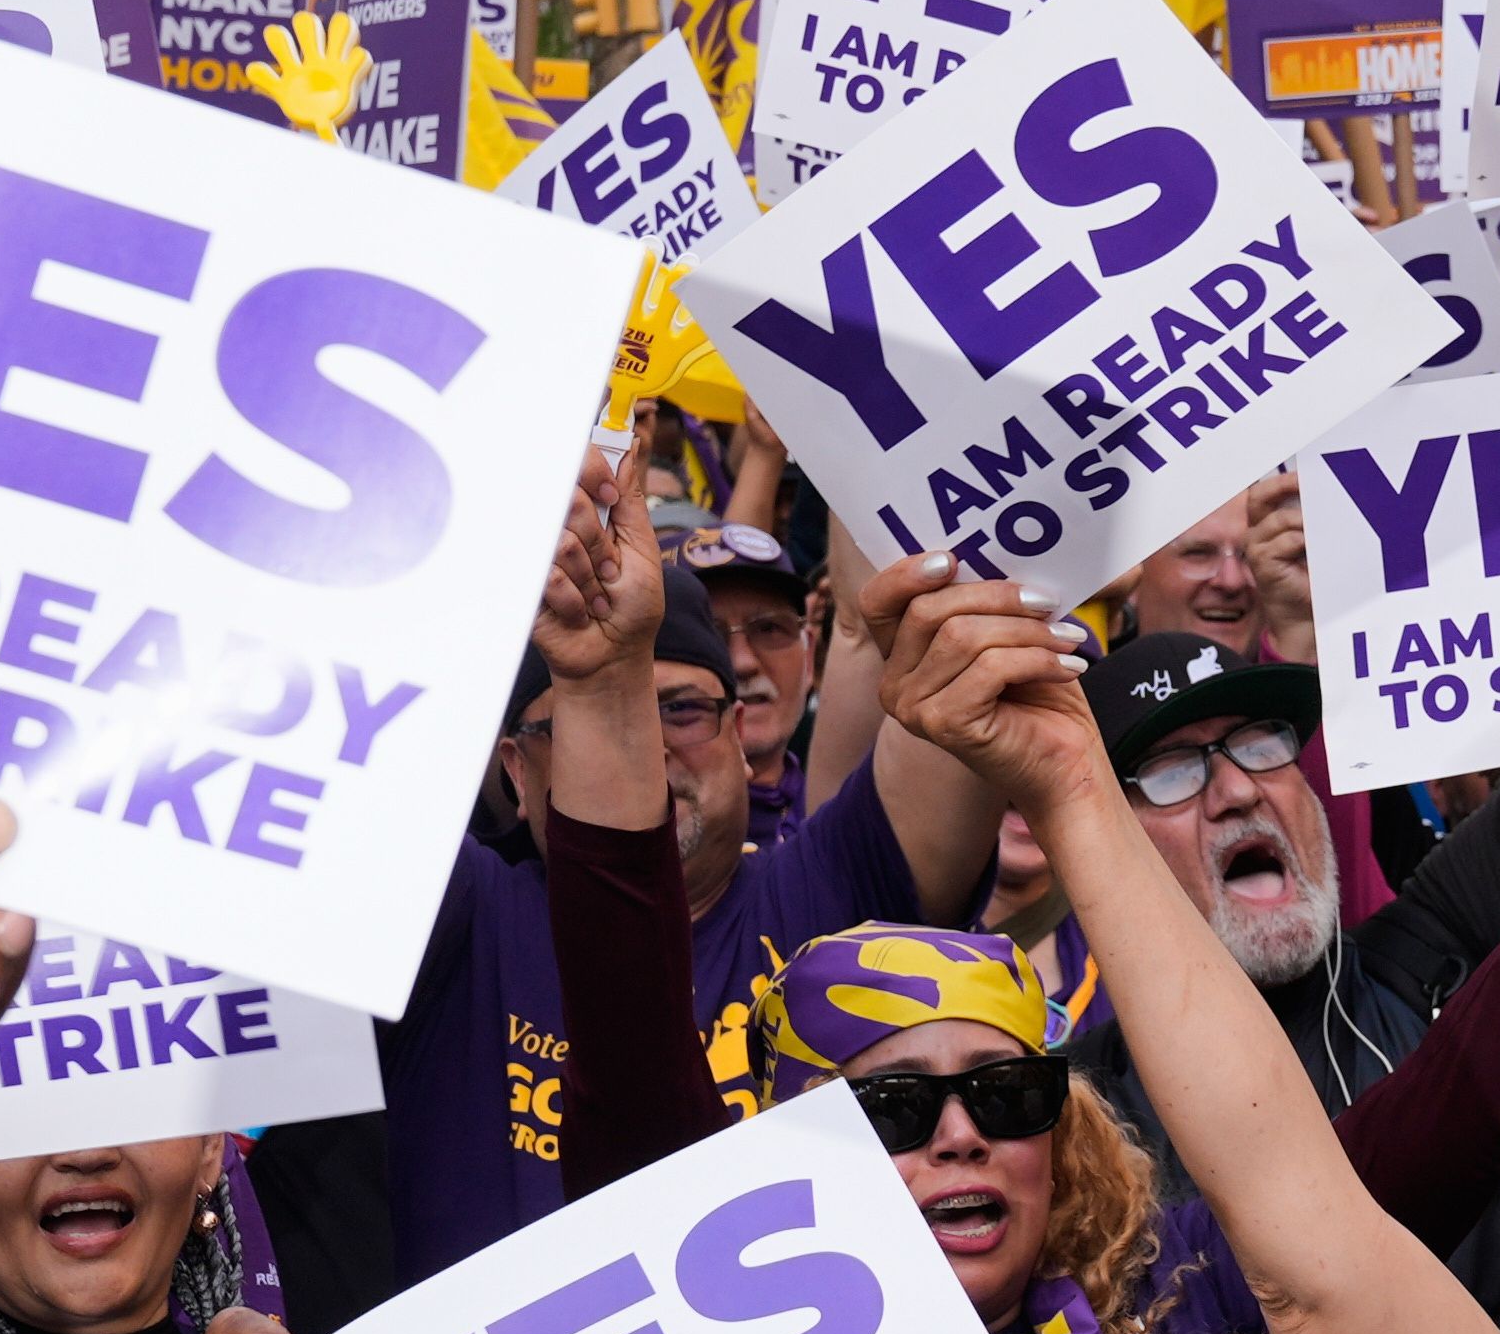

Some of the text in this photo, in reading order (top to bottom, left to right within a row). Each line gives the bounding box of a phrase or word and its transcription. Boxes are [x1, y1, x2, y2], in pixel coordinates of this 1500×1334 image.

[159, 16, 254, 53] NYC
[801, 14, 919, 78] I AM
[816, 63, 884, 113] TO
[733, 56, 1219, 452] YES
[928, 416, 1053, 537] AM
[1042, 215, 1314, 438] READY
[1064, 289, 1348, 512] STRIKE
[1352, 631, 1371, 679] I
[1391, 612, 1494, 676] AM
[1379, 672, 1469, 729] TO
[506, 1012, 571, 1064] Vote
